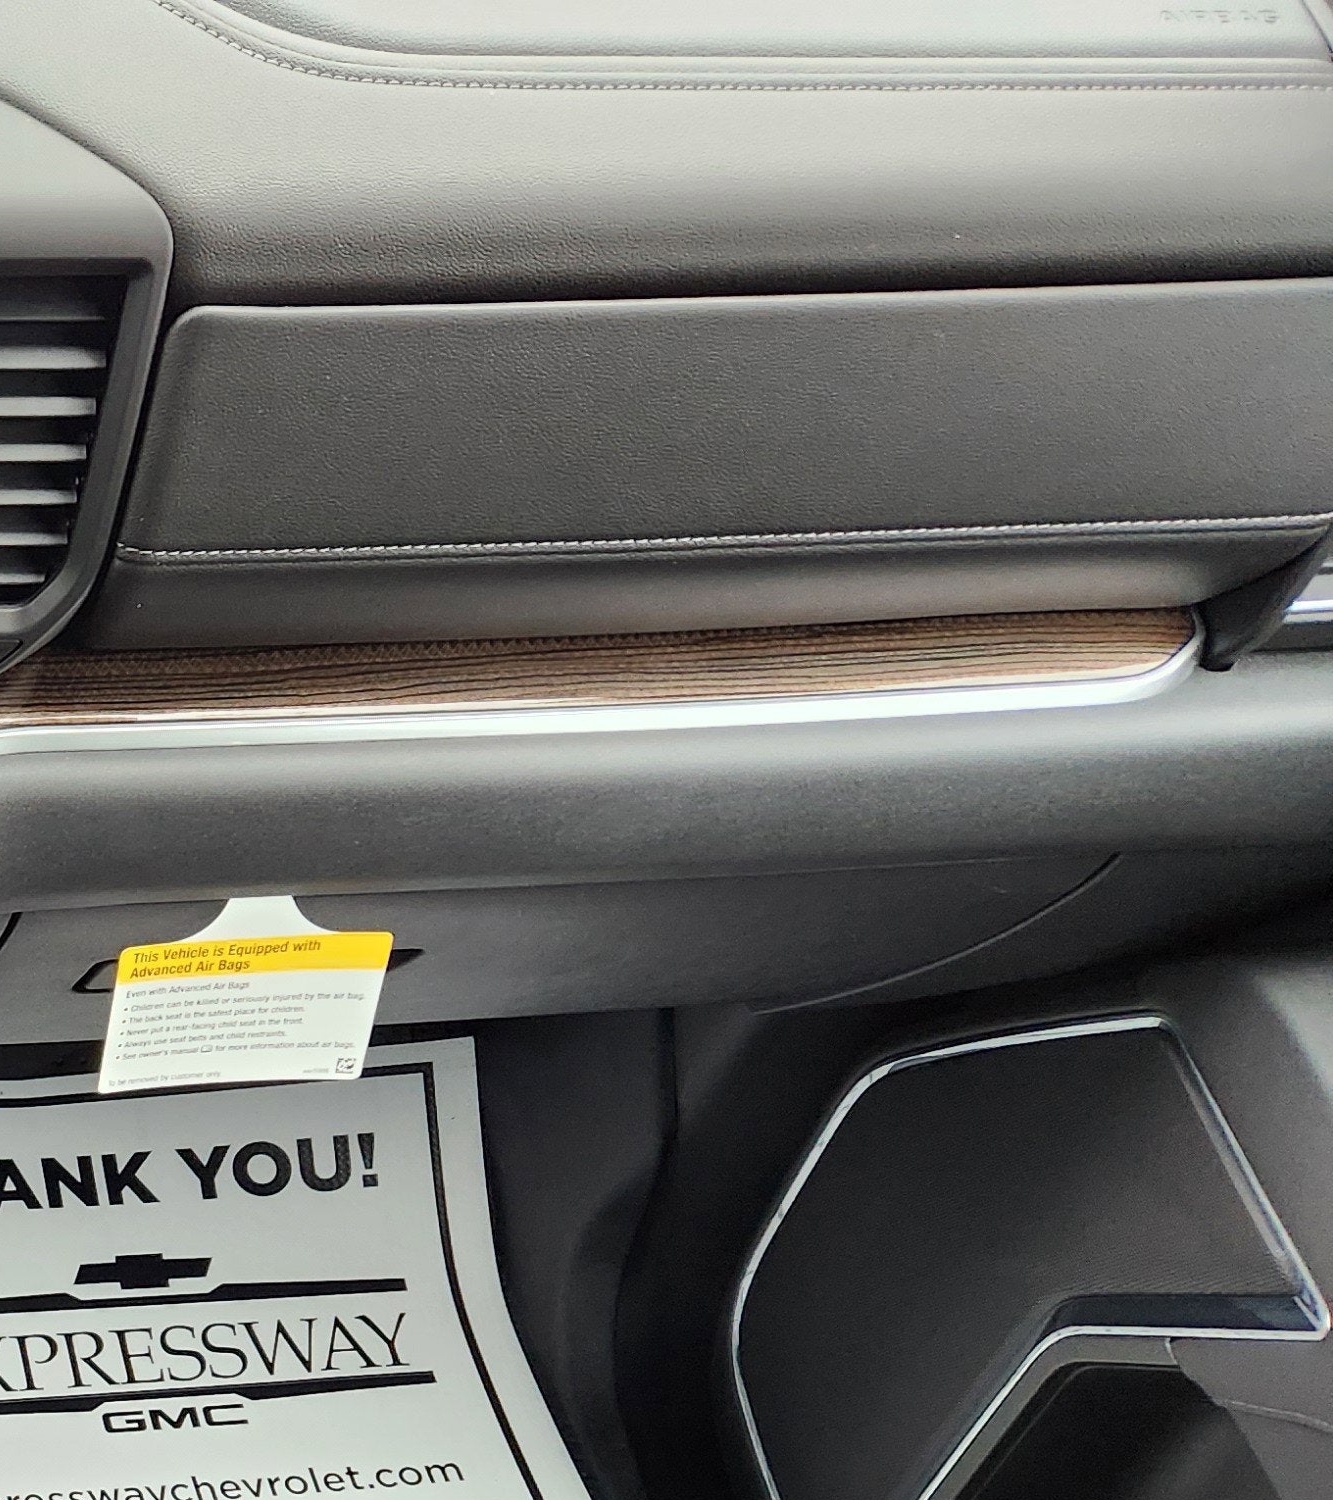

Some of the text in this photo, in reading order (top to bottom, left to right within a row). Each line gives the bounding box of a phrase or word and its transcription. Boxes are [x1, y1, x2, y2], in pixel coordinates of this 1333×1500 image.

[134, 940, 321, 964] This Vehicle is Equipped with
[130, 959, 250, 979] Advanced Air Bags
[126, 990, 146, 999] Even
[168, 984, 211, 994] Advanced
[213, 982, 225, 990] Air
[228, 982, 249, 990] Bags
[176, 1132, 380, 1201] YOU!
[101, 1402, 250, 1434] GMC
